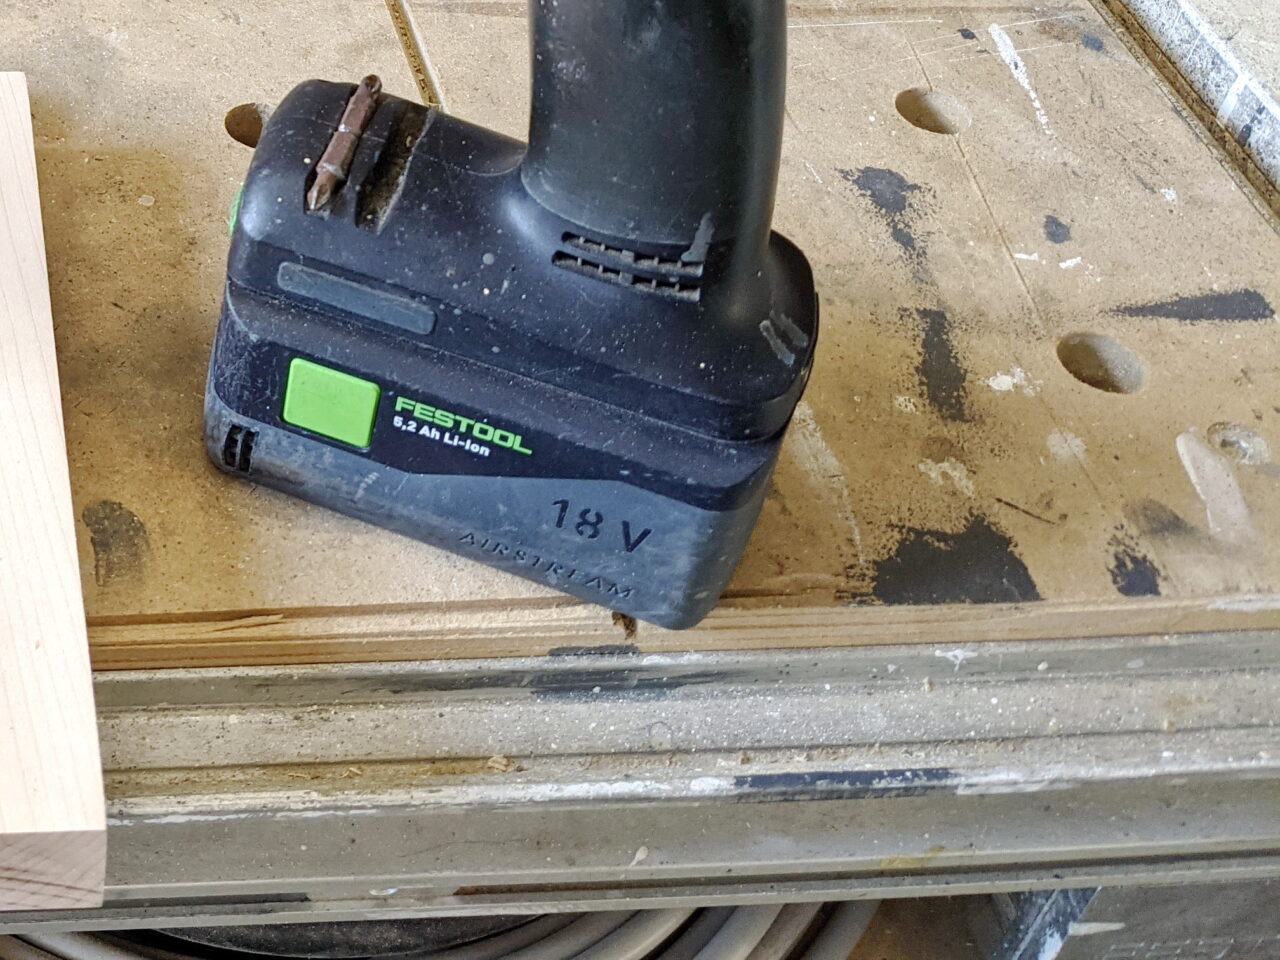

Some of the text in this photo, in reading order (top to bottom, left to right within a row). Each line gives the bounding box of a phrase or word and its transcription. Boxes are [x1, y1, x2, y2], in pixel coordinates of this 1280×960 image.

[393, 415, 491, 457] 5,2 Ah Li-Ion
[395, 396, 533, 456] FESTOOL
[552, 498, 652, 553] 18 V
